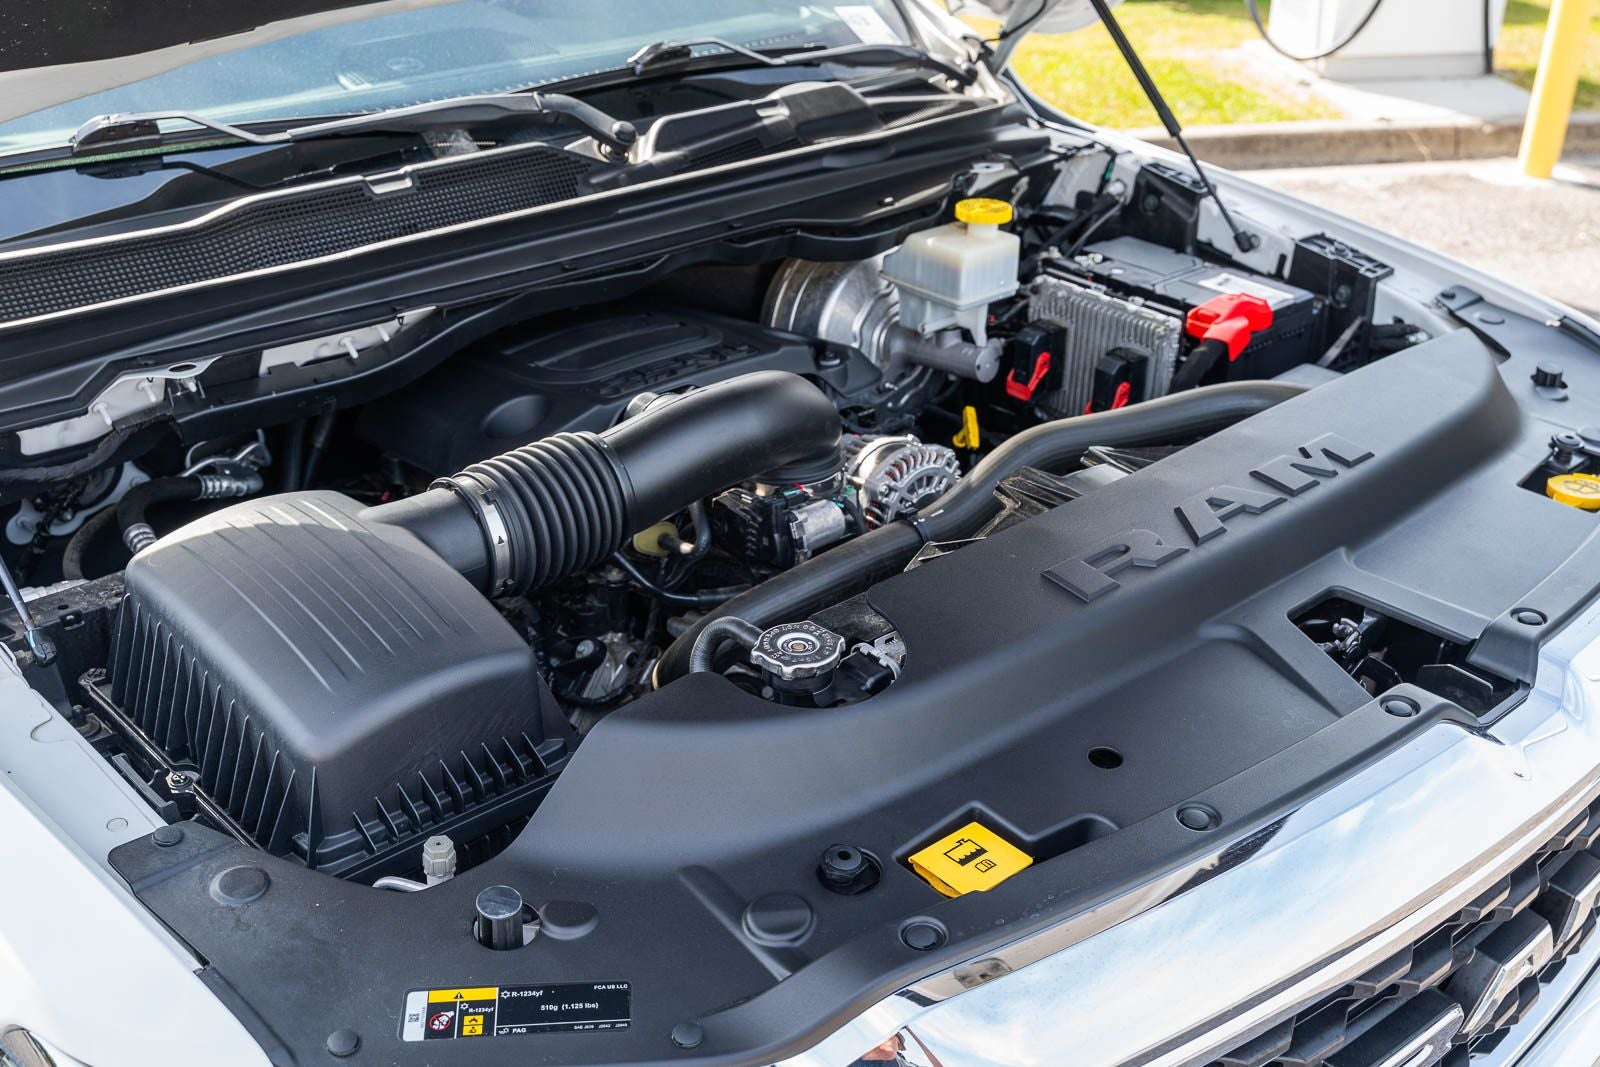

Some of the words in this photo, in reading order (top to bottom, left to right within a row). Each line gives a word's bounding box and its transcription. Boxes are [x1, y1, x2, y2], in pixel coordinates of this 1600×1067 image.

[1040, 432, 1375, 602] RAM
[511, 990, 543, 998] R-1234yf
[540, 1003, 558, 1011] 510g
[561, 1002, 584, 1010] (1.125
